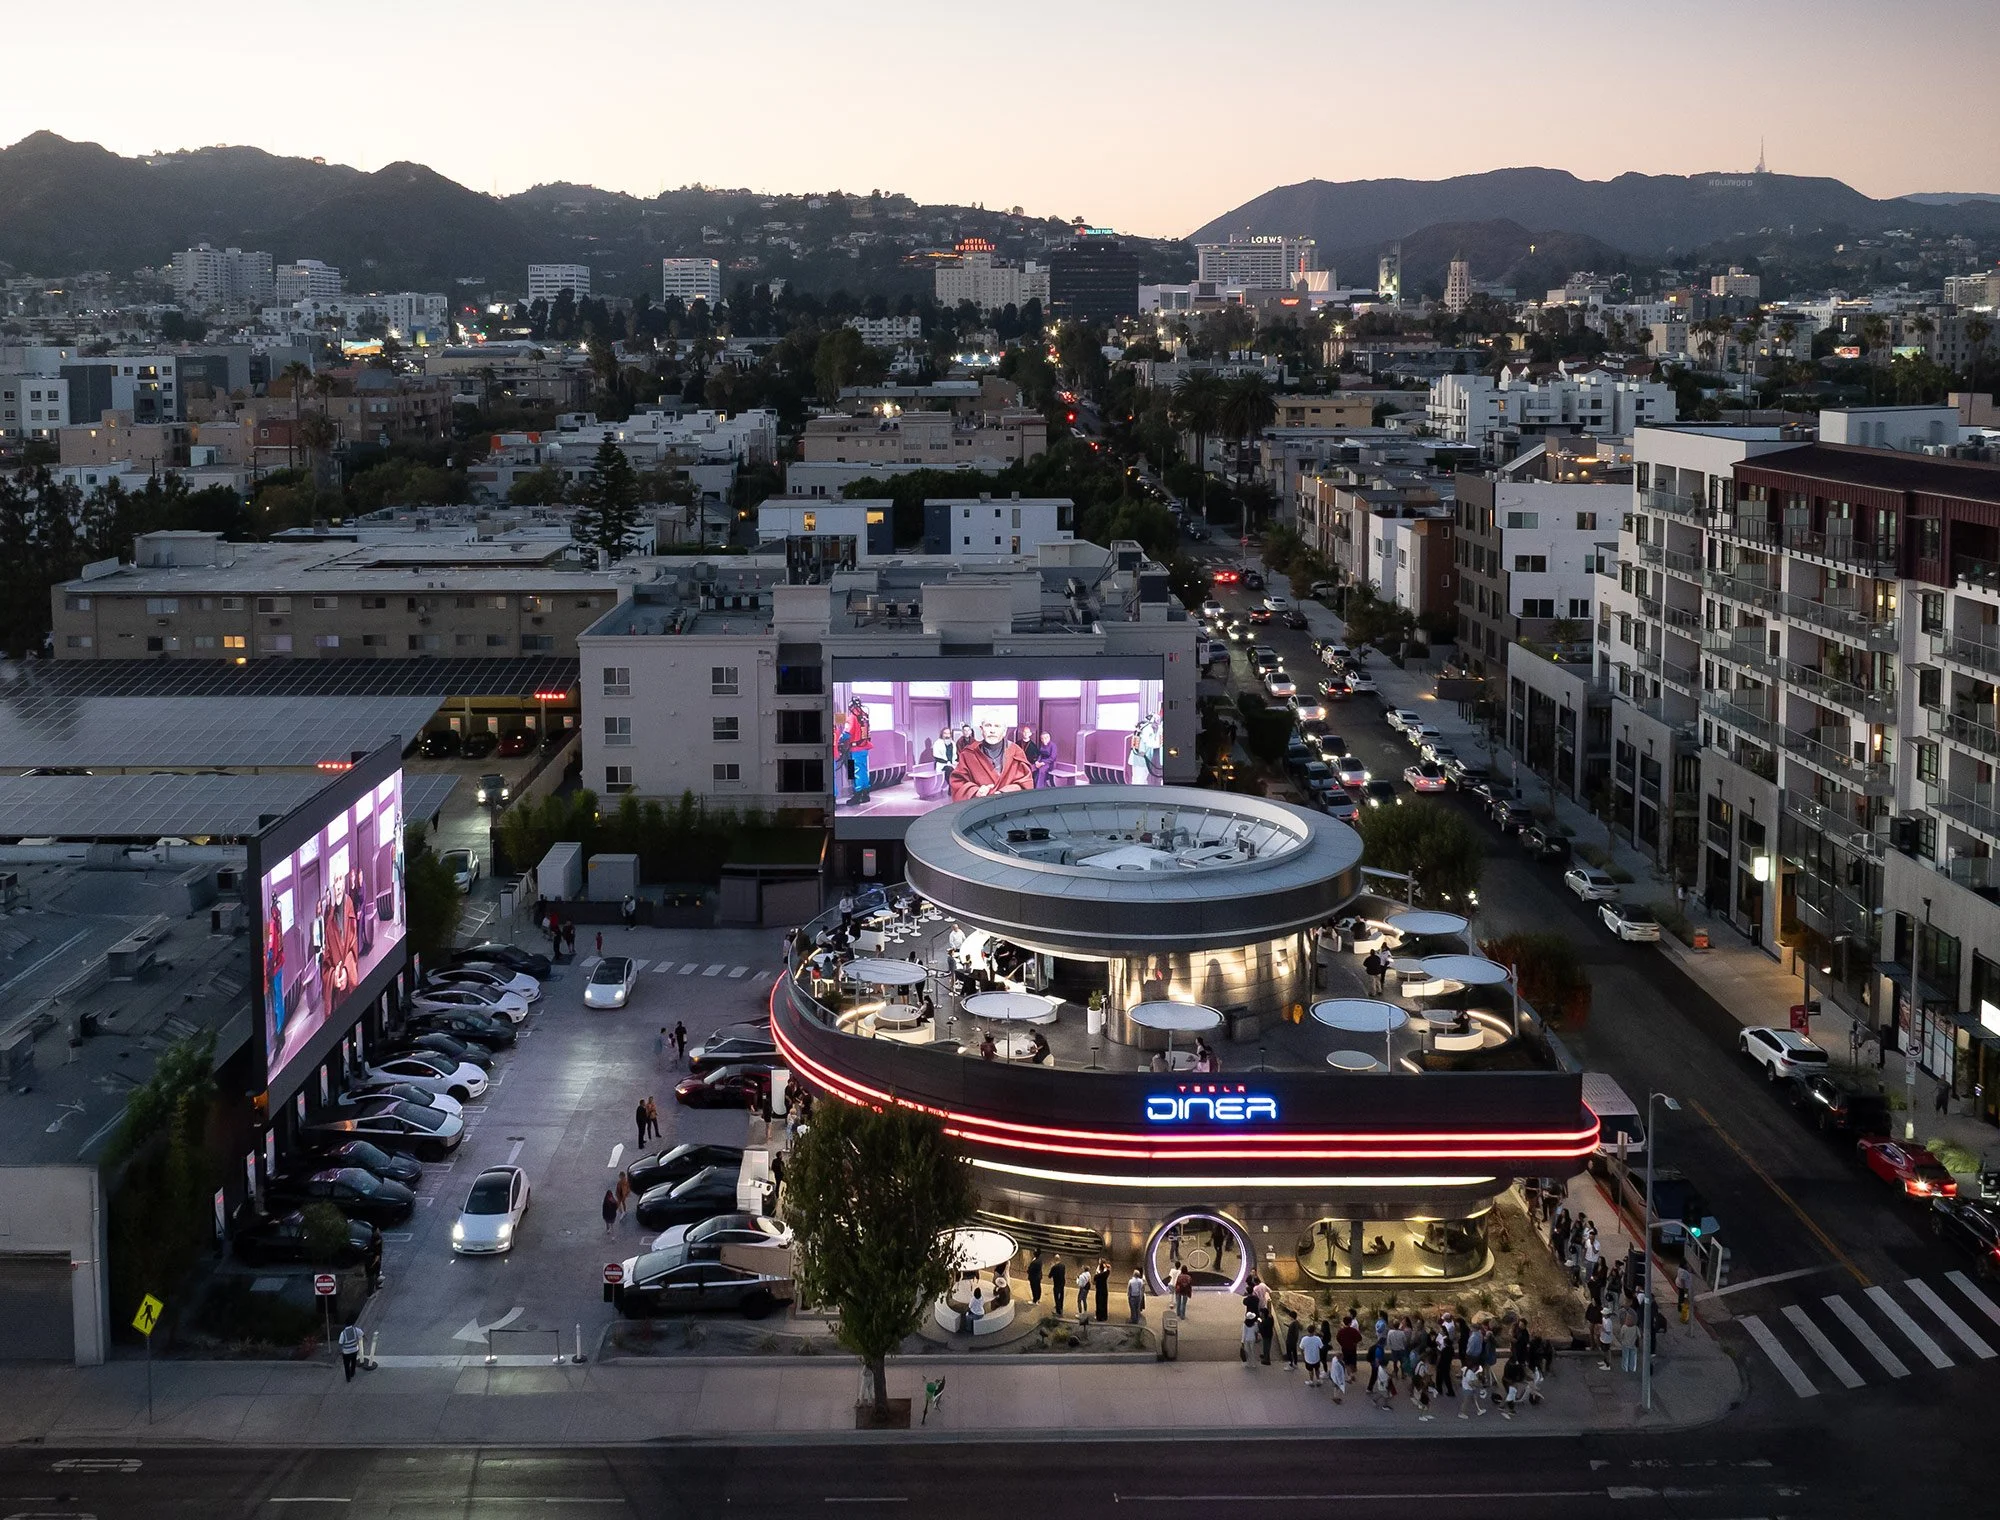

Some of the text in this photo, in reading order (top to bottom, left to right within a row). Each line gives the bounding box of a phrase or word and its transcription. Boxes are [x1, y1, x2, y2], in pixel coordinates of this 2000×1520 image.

[1251, 236, 1282, 244] LOEWS
[1179, 1085, 1246, 1093] TESLA
[1147, 1097, 1277, 1120] DINER
